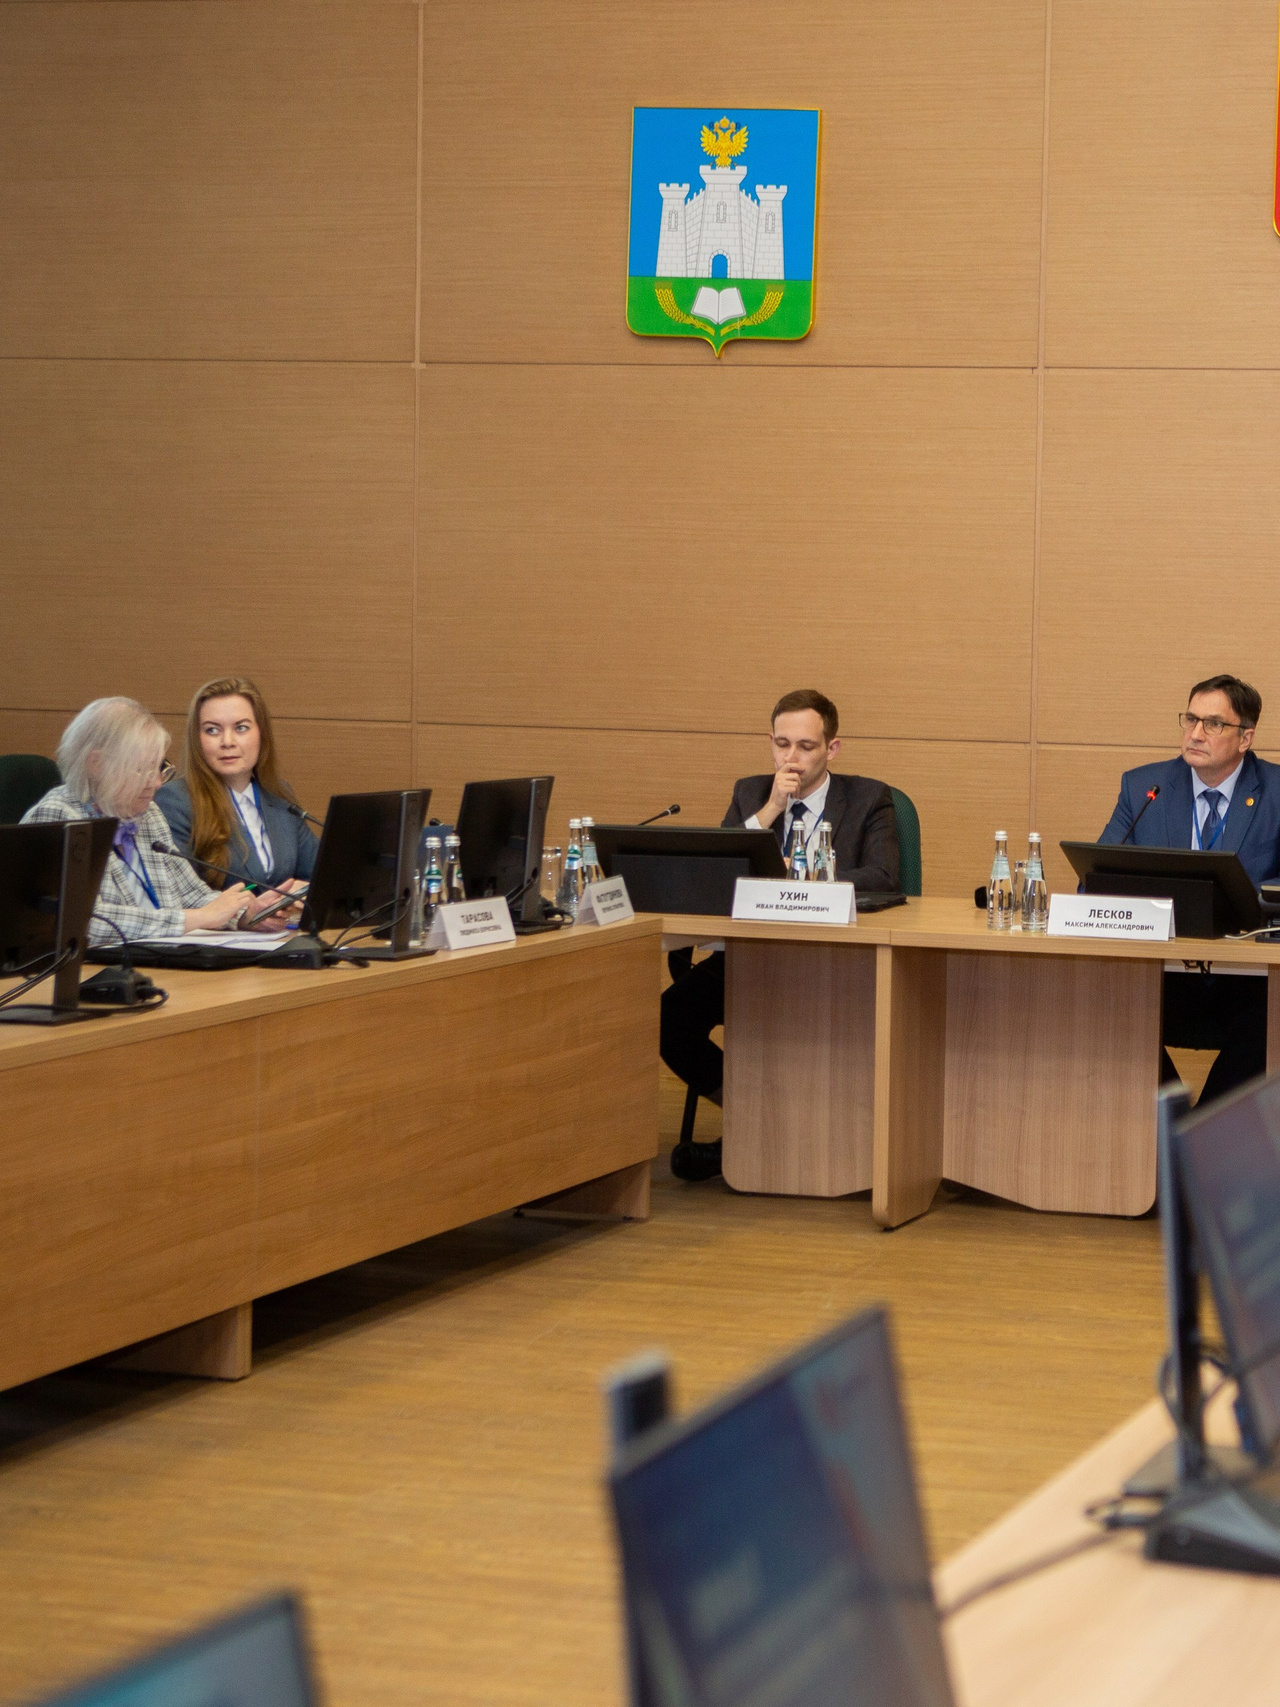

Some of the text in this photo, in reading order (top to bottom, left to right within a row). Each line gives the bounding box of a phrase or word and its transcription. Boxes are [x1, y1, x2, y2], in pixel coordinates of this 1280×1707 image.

[779, 891, 809, 901] УХИН
[775, 904, 830, 913] ВЛАДИМИРОВИЧ
[460, 911, 495, 924] ТАРАСОВА
[1088, 908, 1133, 920] ЛЕСКОВ
[1095, 922, 1155, 931] АЛЕКСАНДРОВИЧ
